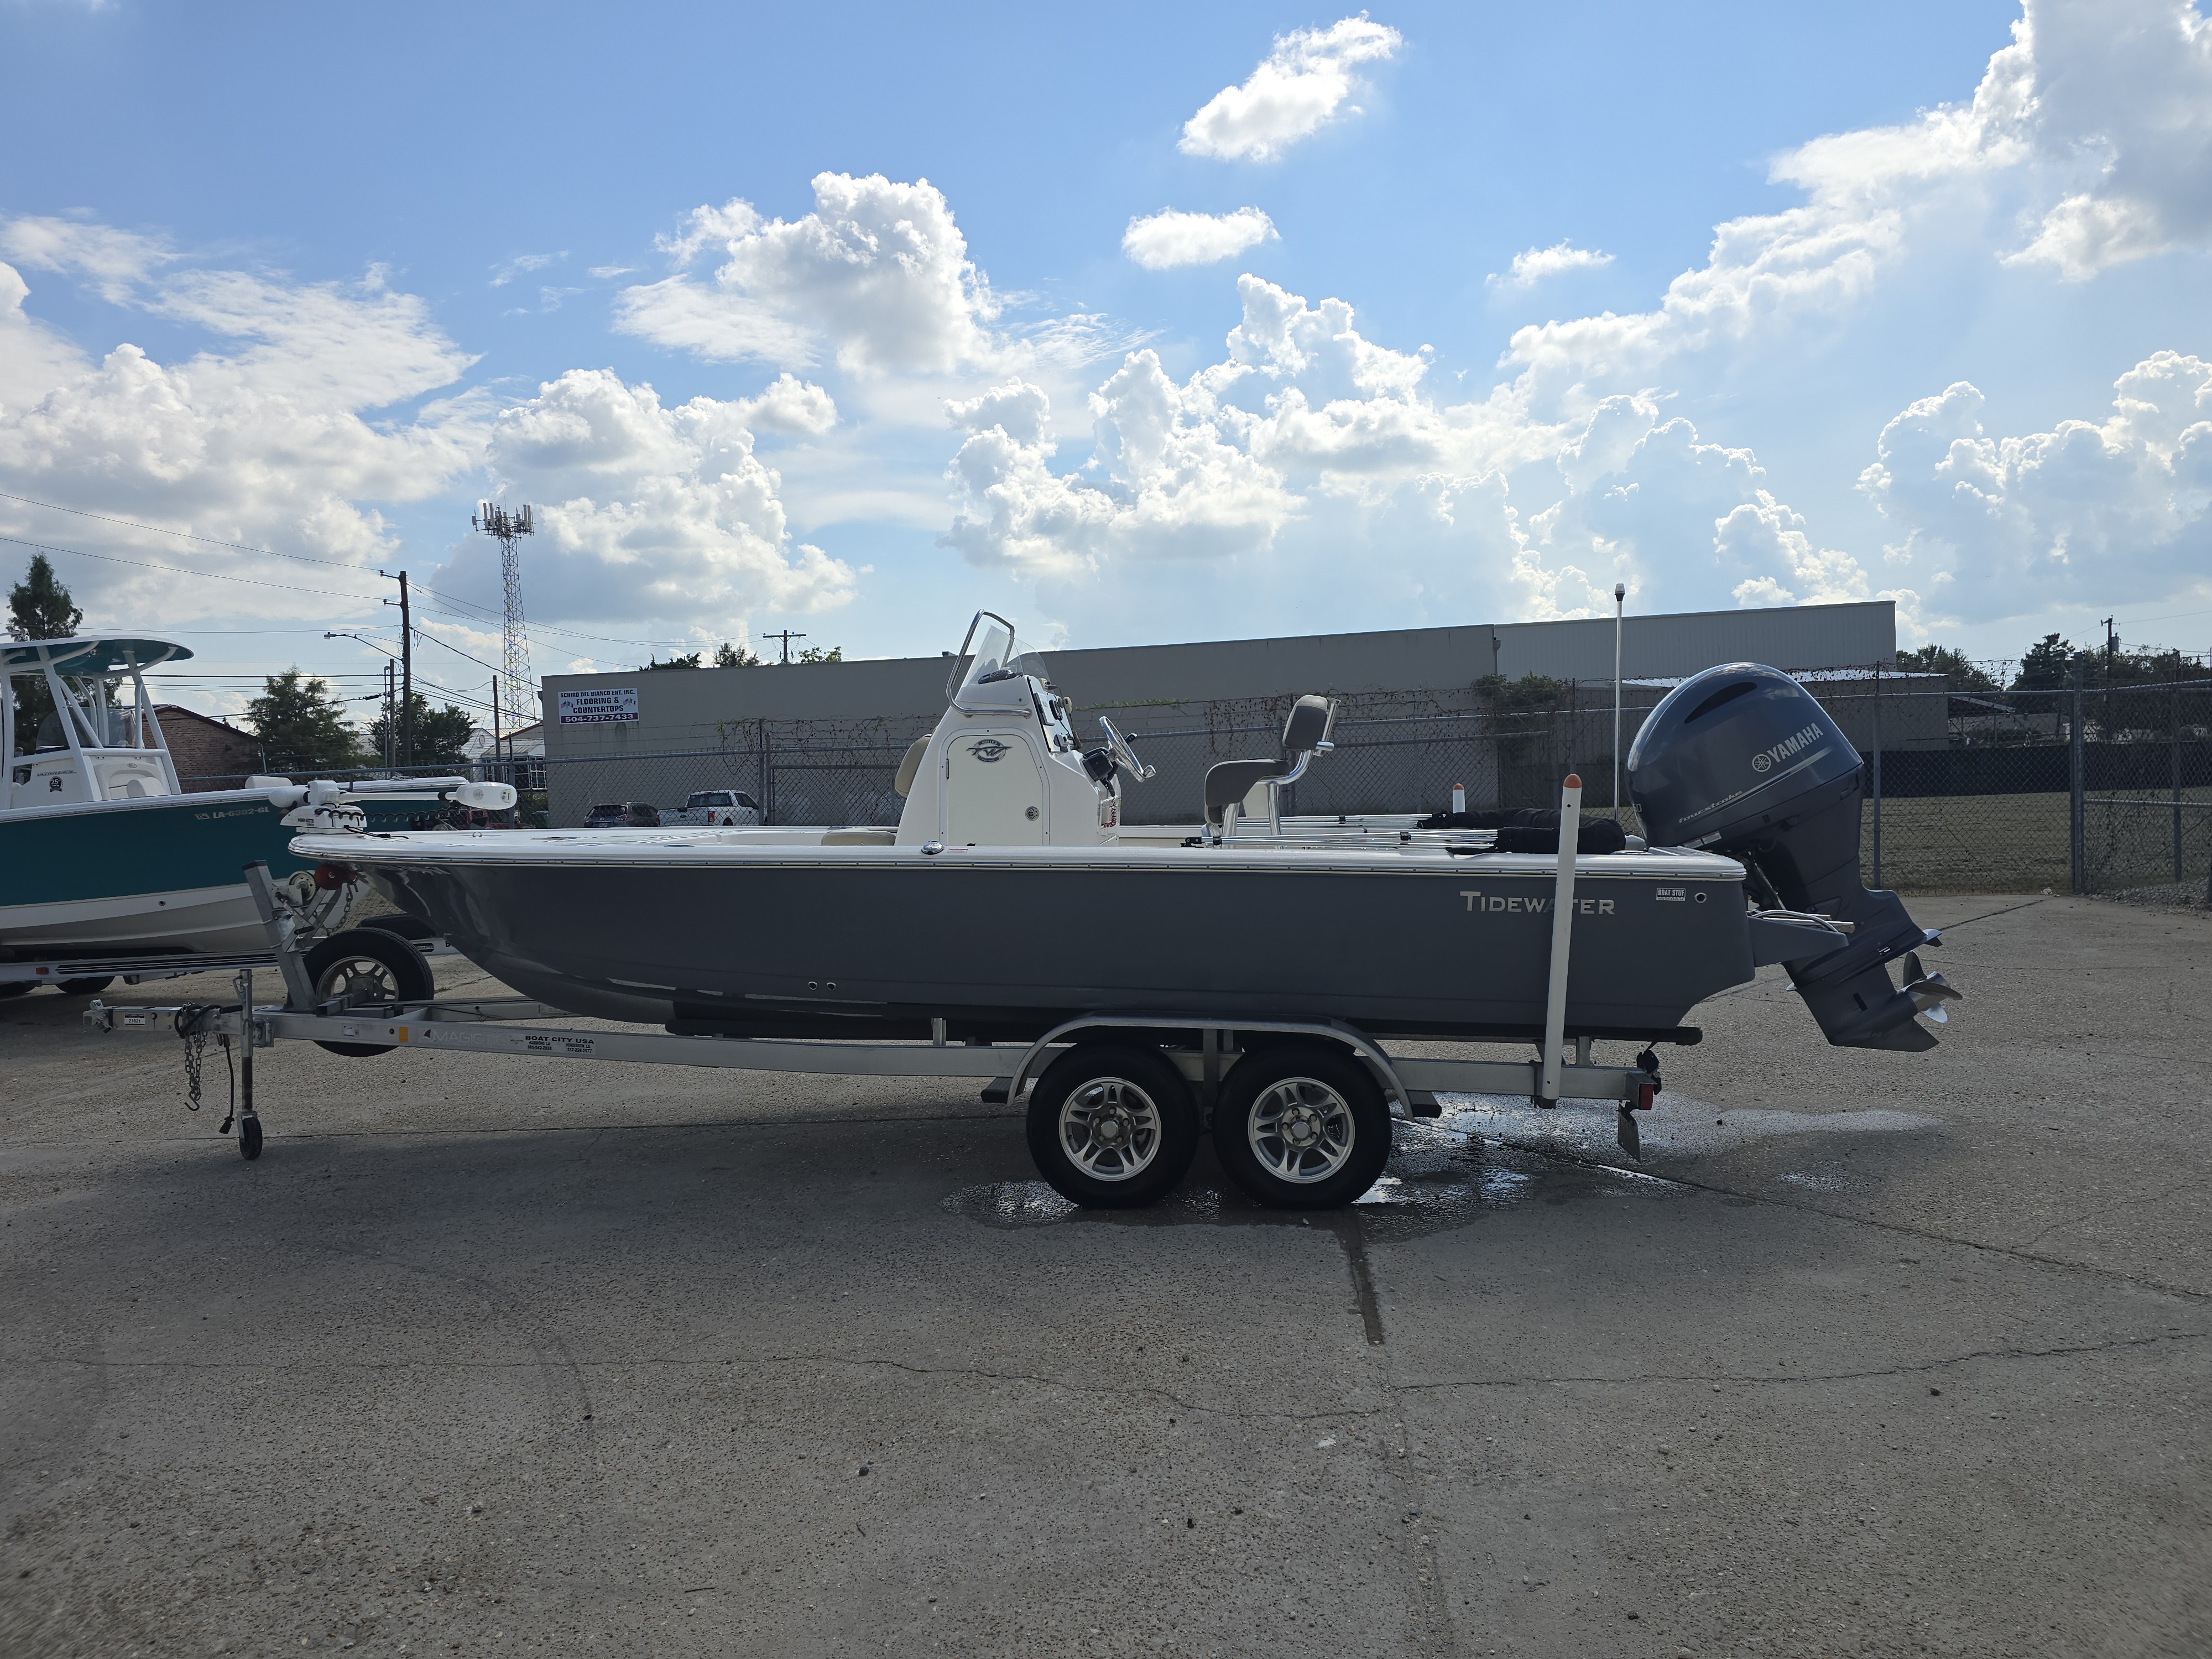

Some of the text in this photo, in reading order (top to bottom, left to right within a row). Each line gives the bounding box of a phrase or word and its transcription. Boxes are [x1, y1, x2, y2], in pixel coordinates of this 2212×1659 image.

[573, 705, 624, 714] COUNTERTOPS
[565, 714, 634, 722] 504-737-7433
[1767, 722, 1824, 763] YAMAHA
[212, 806, 269, 818] LA-6302-GL
[433, 1030, 483, 1044] MAGIC
